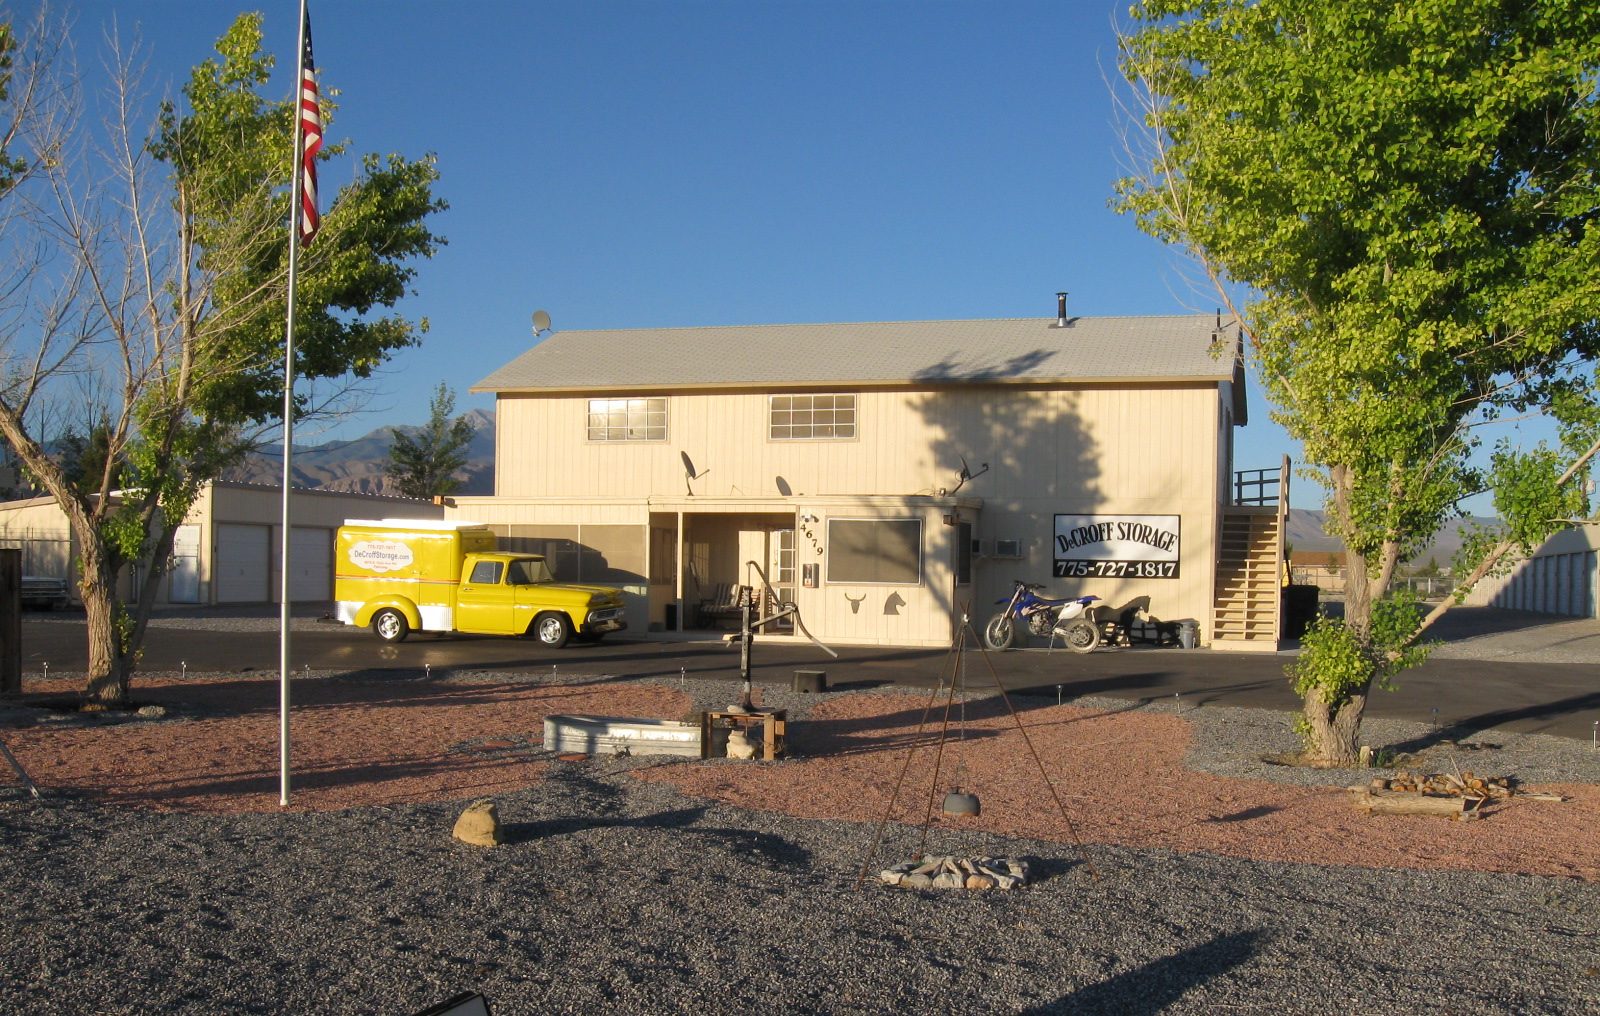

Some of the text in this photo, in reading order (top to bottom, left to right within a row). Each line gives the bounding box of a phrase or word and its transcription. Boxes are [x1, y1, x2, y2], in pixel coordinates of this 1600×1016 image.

[1056, 521, 1178, 553] DeCROFF STORAGE
[354, 550, 410, 561] DeCroffStorage.com
[1057, 561, 1177, 577] 775-727-1817
